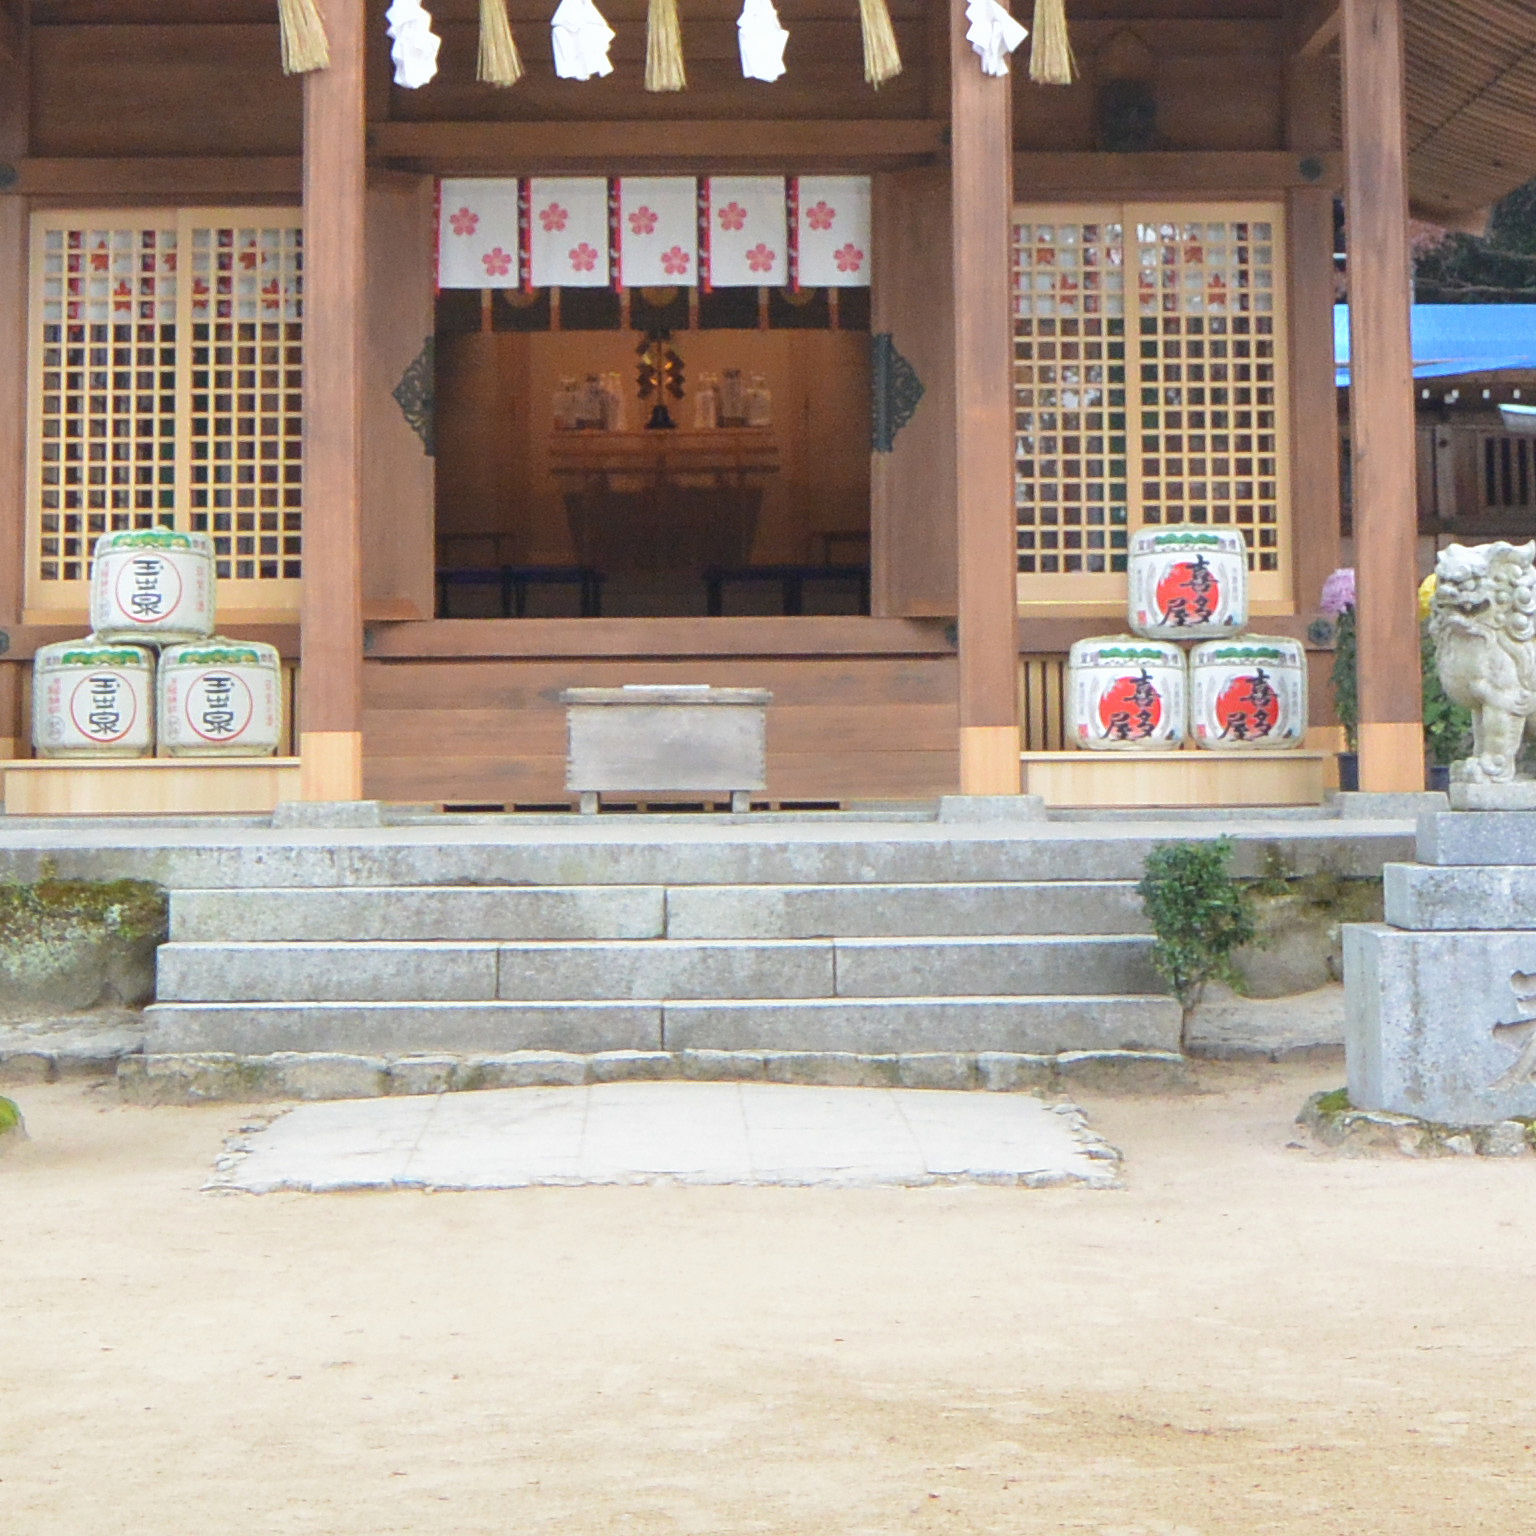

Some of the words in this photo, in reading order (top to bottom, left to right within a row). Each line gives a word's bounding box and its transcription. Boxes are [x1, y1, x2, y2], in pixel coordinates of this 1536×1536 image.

[131, 559, 164, 616] 玉出泉
[88, 677, 121, 734] 玉出泉
[202, 677, 235, 734] 玉出泉
